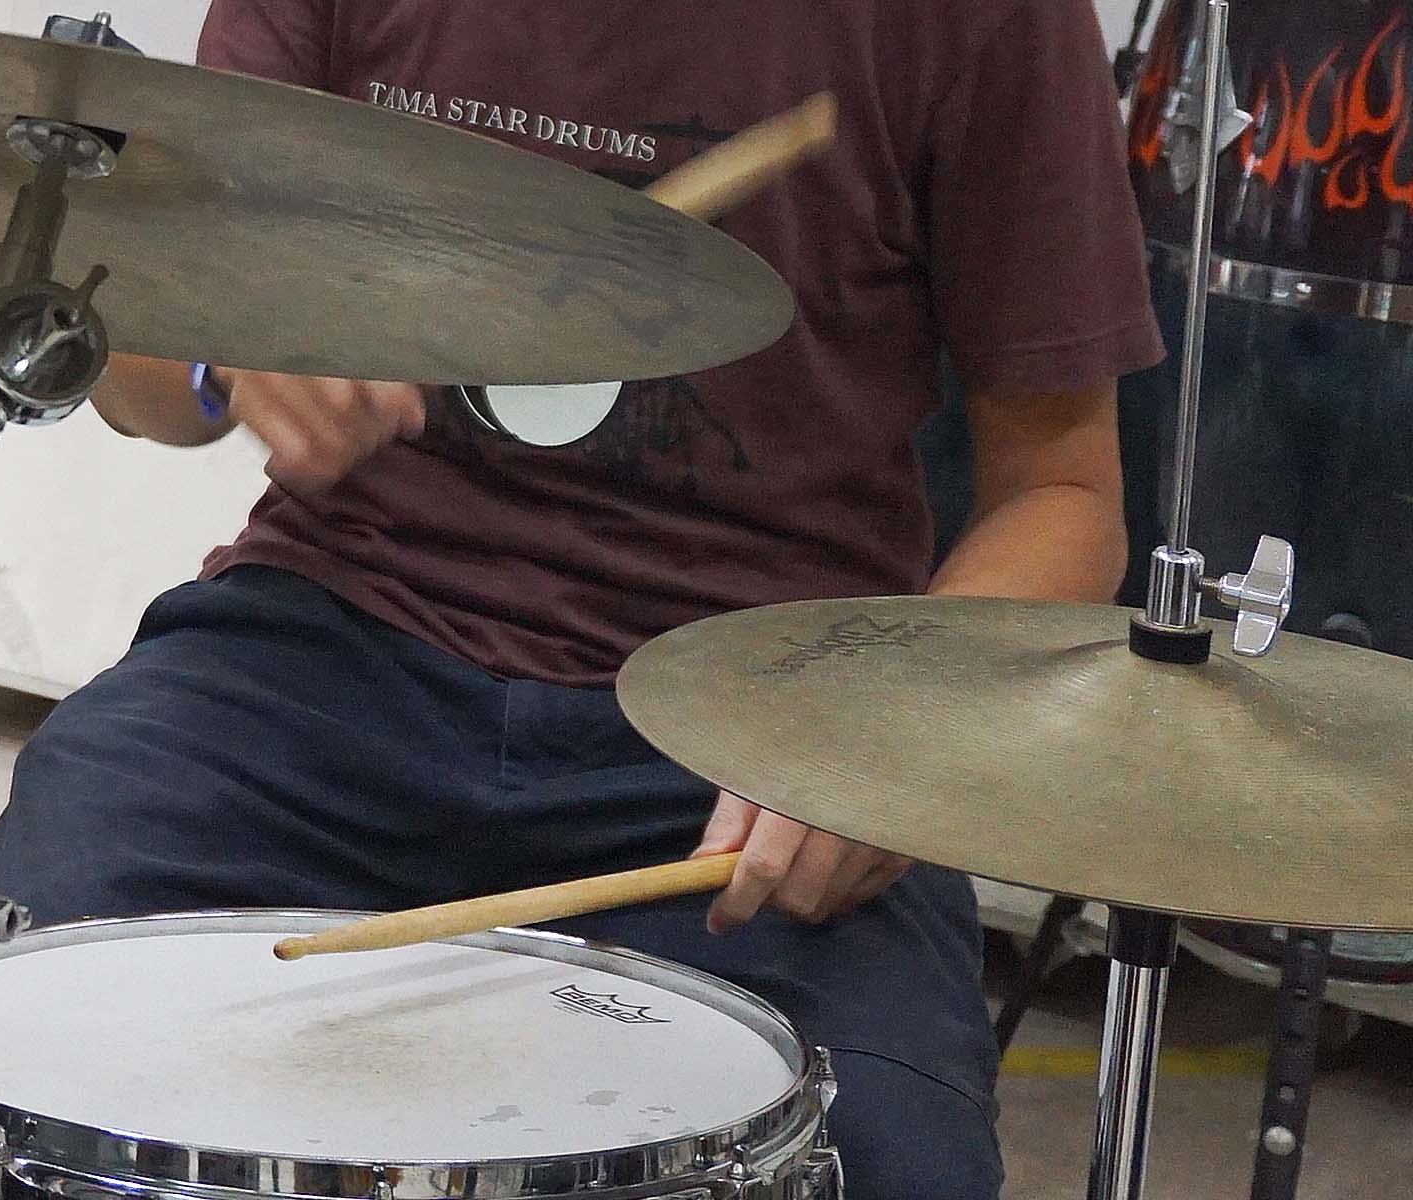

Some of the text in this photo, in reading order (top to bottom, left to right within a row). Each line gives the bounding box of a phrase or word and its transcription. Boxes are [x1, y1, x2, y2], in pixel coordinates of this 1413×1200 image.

[368, 81, 657, 162] TAMA STAR DRUMS
[560, 990, 641, 1021] REMO
